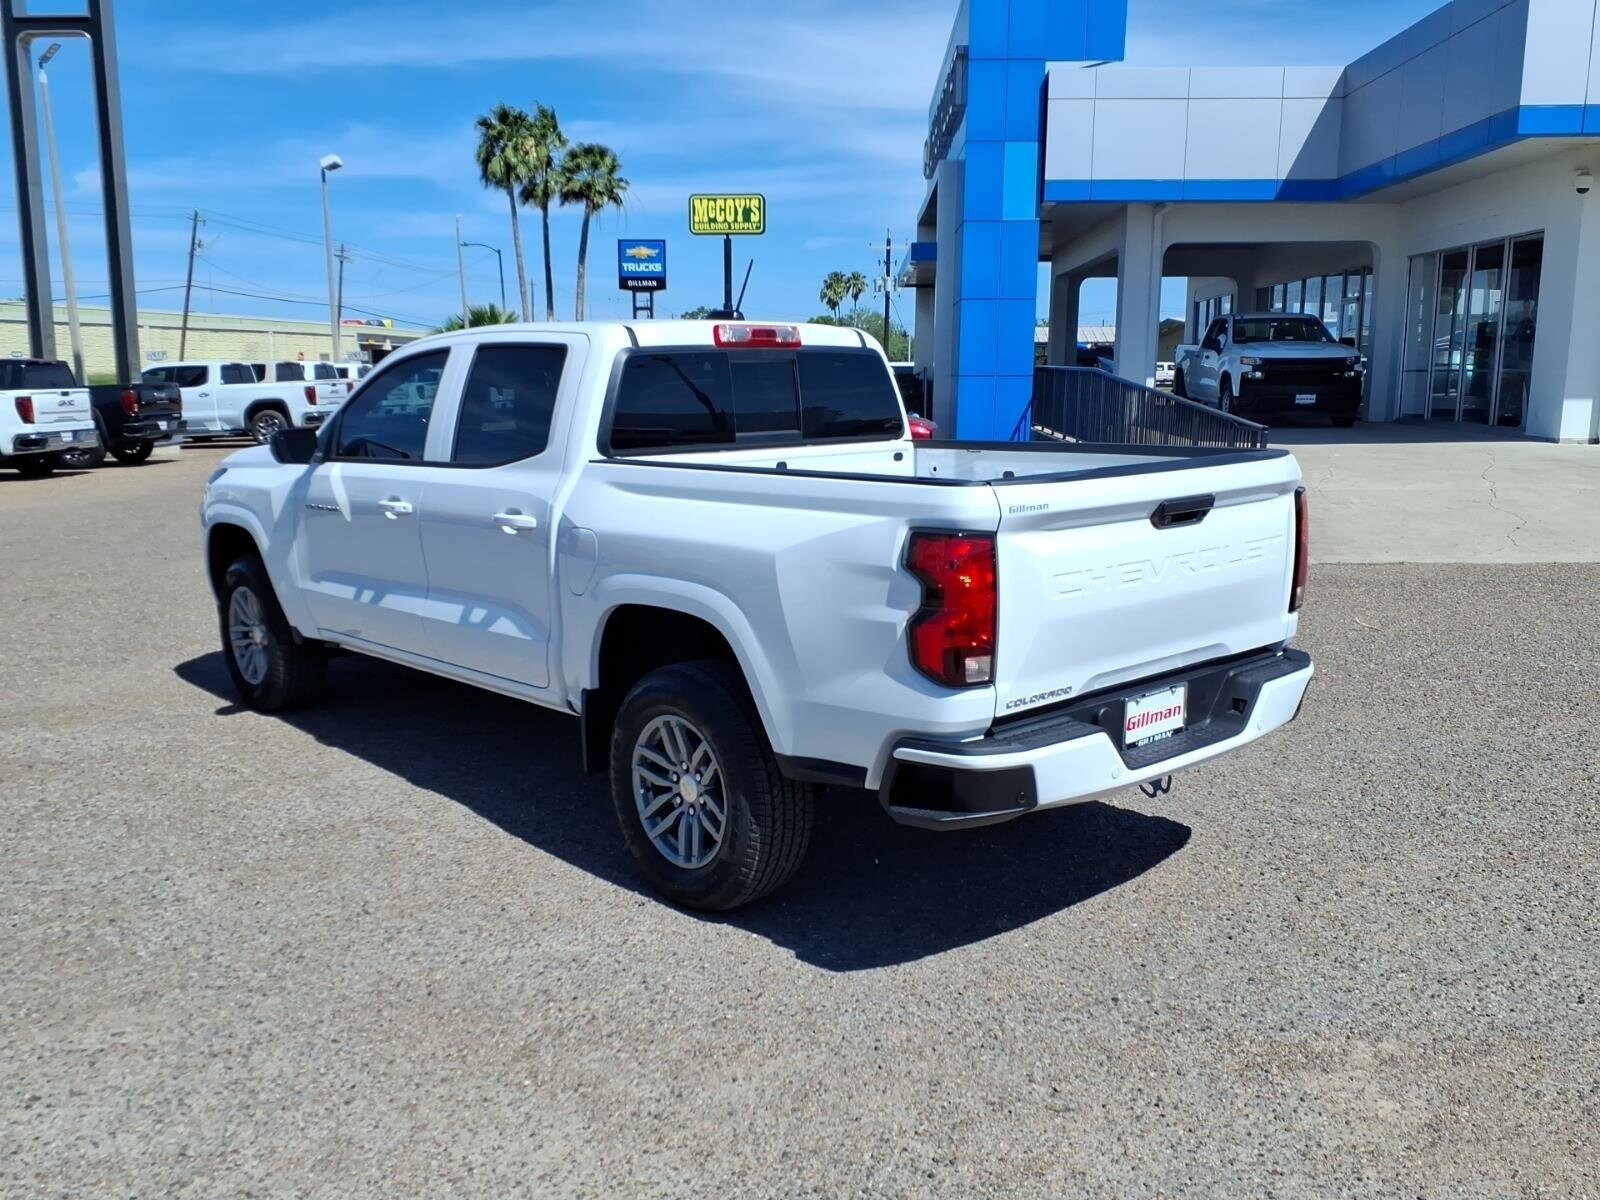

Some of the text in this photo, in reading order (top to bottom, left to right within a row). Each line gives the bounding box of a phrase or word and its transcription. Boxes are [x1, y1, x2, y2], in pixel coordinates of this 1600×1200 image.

[694, 222, 757, 230] BUILDING SUPPLY
[622, 262, 662, 272] TRUCKS
[1009, 503, 1049, 514] Gillman
[1005, 686, 1073, 710] COLORADO
[1126, 705, 1182, 731] Gillman
[1136, 730, 1174, 747] GILLMAN
